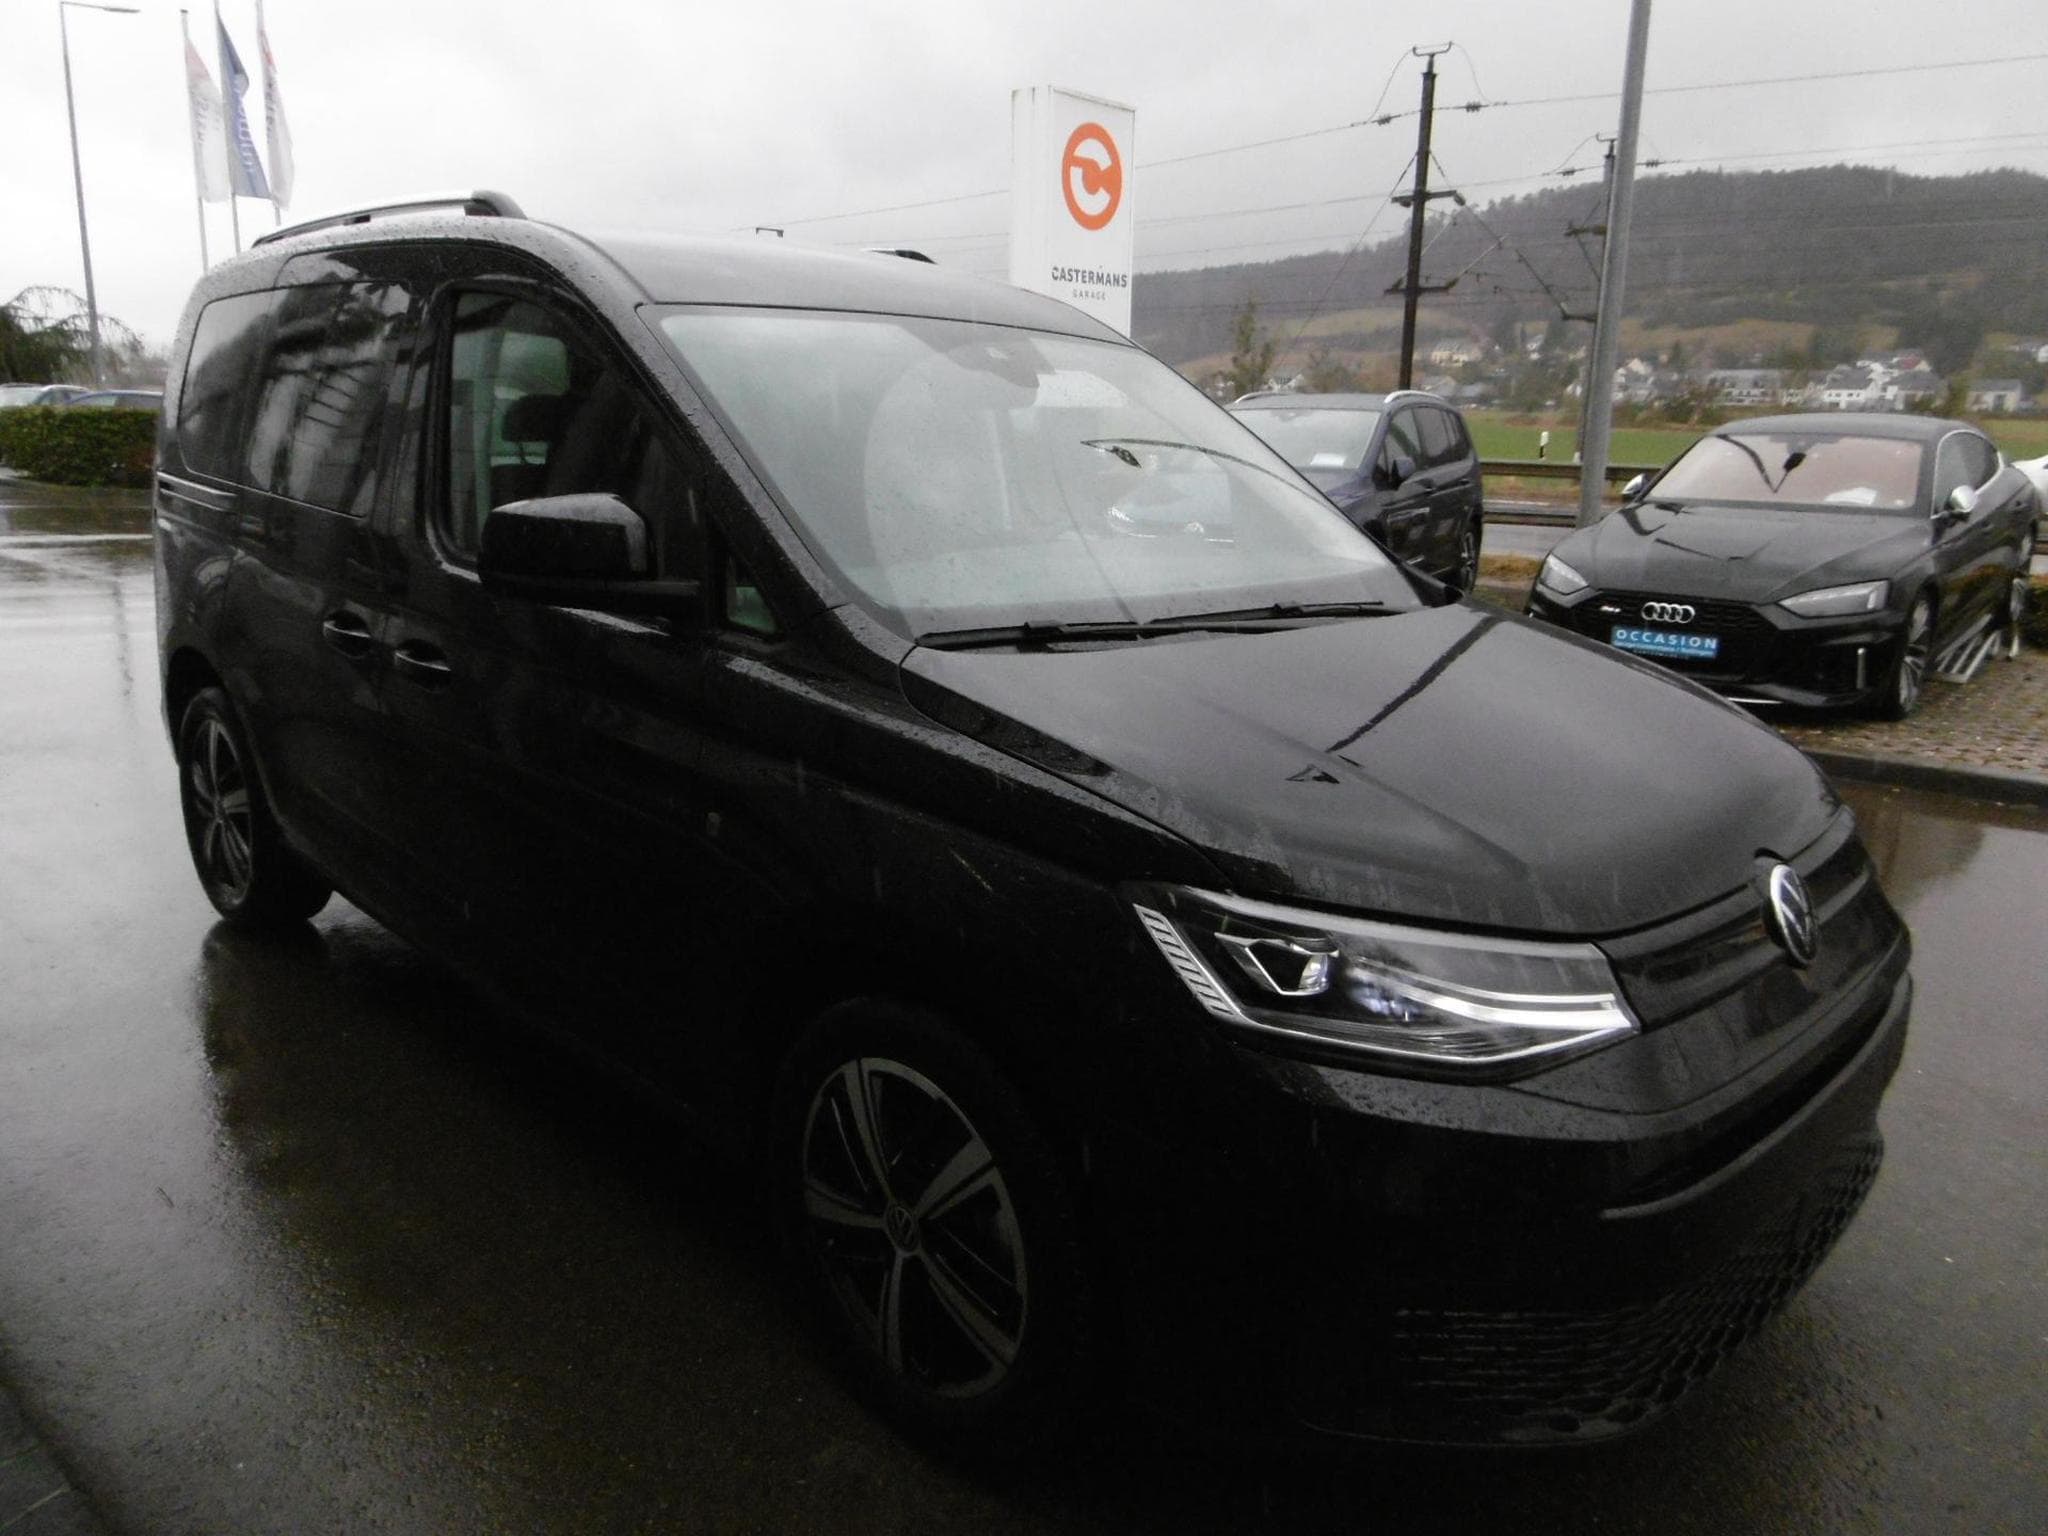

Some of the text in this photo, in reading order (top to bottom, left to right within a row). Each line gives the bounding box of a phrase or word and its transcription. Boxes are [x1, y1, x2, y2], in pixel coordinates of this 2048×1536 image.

[1051, 265, 1128, 288] CASTERMANS
[1073, 289, 1106, 301] GARAGE
[1616, 629, 1718, 649] OCCASION
